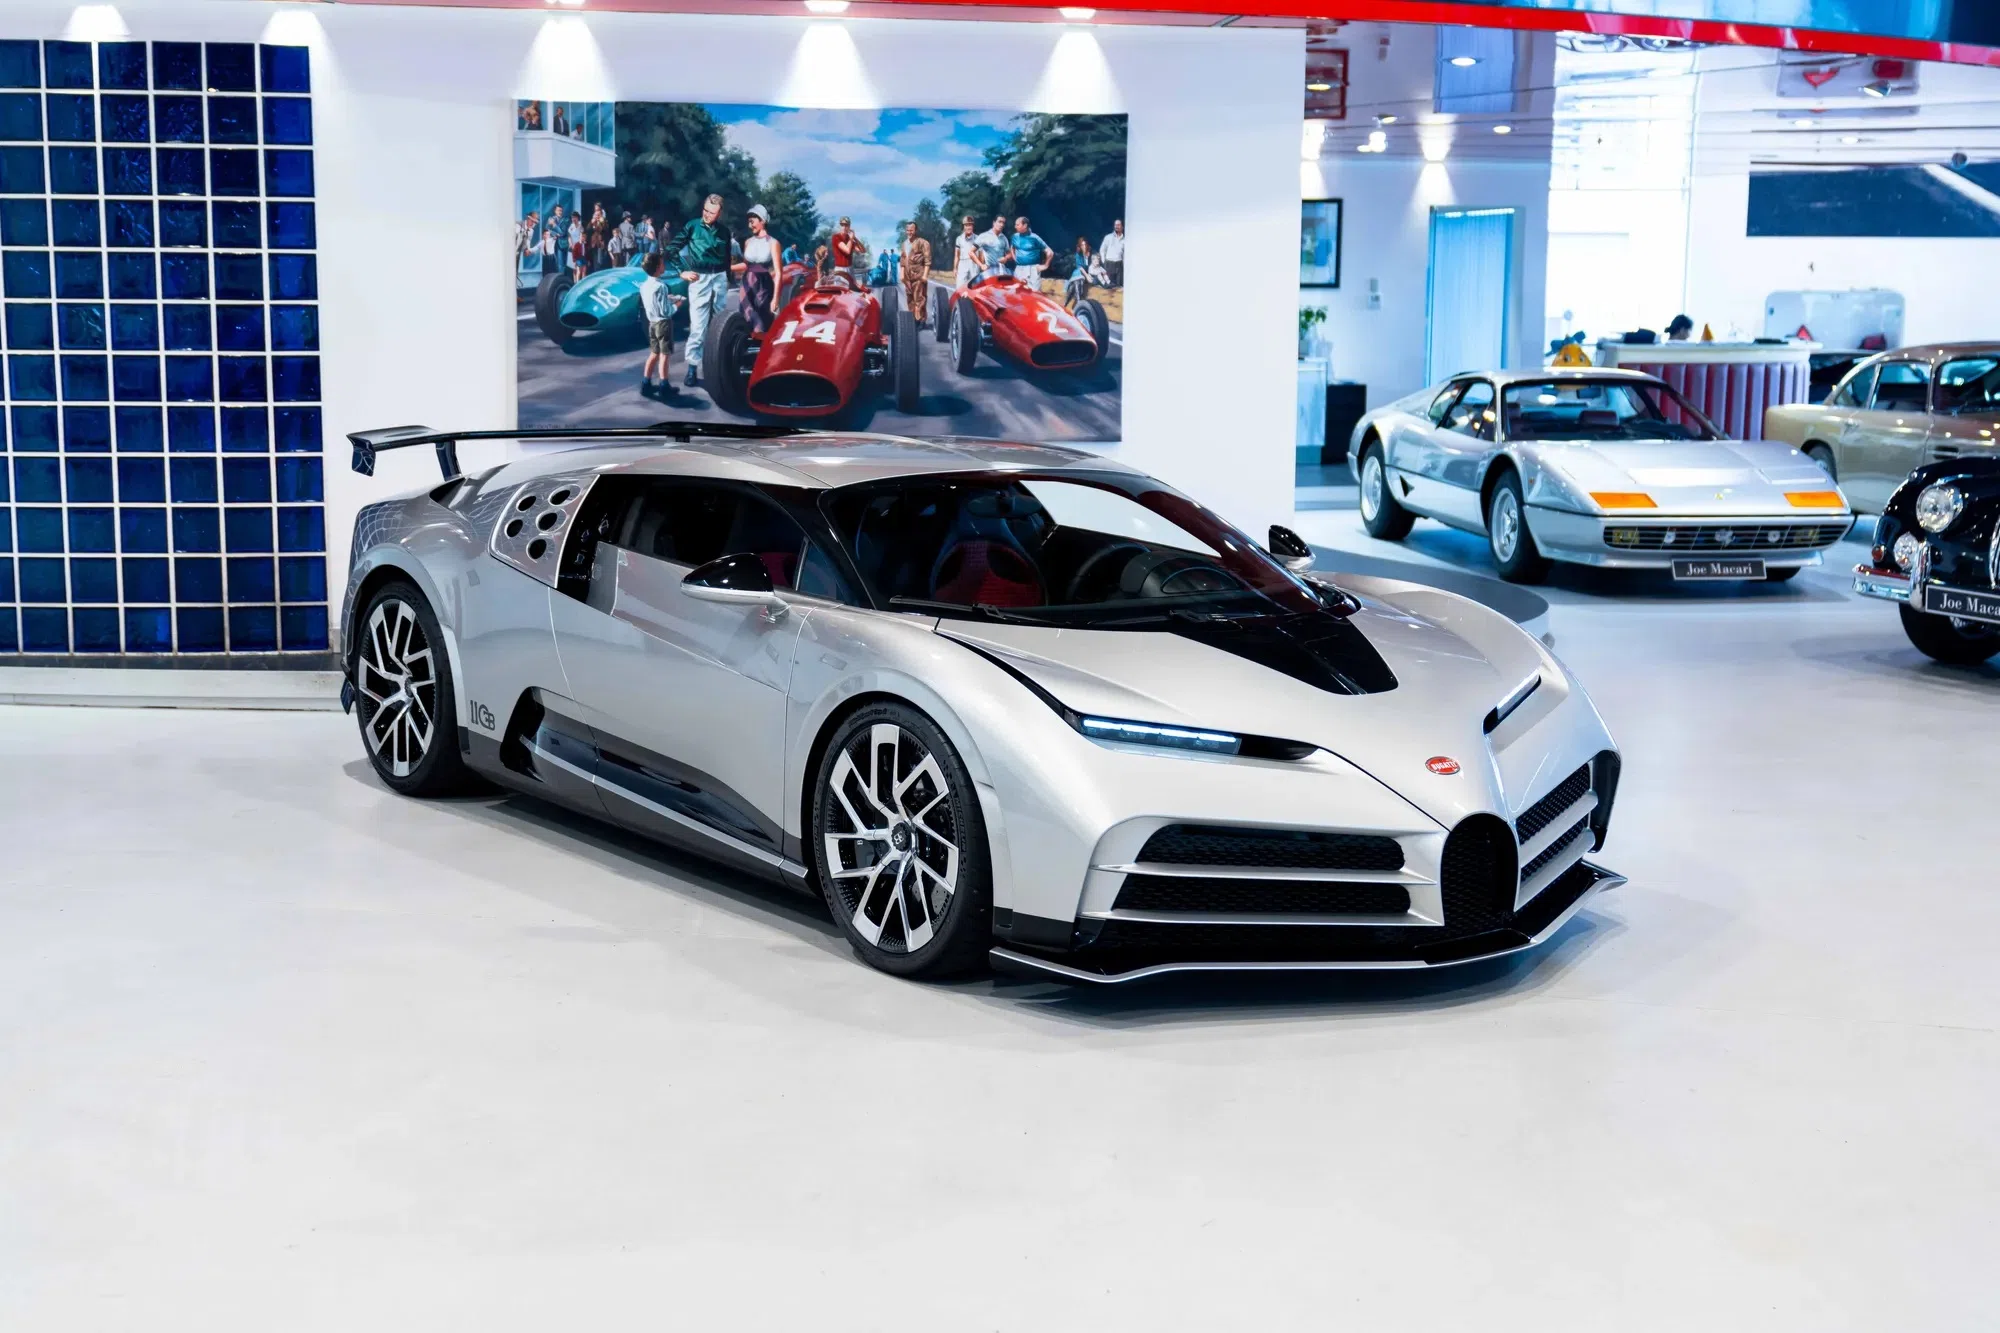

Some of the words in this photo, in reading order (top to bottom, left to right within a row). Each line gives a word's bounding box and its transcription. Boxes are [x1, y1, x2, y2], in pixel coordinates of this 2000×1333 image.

[589, 288, 620, 309] 18
[772, 320, 836, 345] 14
[1037, 312, 1068, 333] 2
[1686, 562, 1707, 576] Joe
[1710, 562, 1752, 575] Macari
[1940, 593, 1962, 609] Joe
